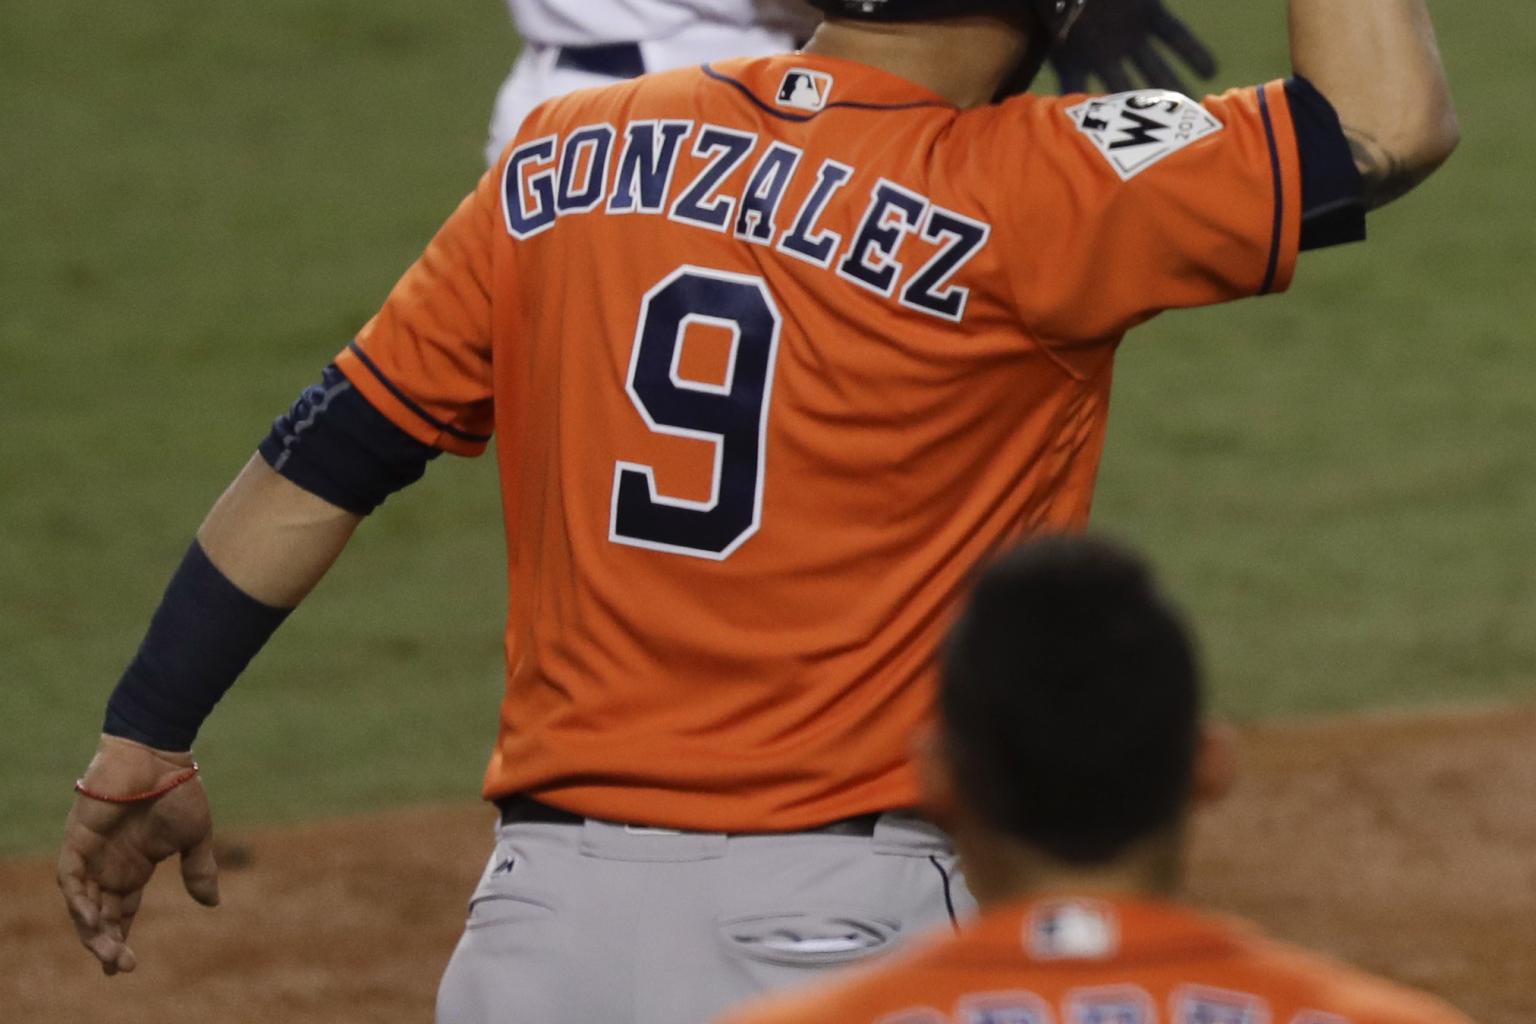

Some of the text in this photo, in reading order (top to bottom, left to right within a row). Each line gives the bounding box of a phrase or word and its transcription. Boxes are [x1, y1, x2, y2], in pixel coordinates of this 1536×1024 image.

[501, 119, 992, 323] GONZALEZ
[1108, 93, 1180, 150] WS
[608, 263, 784, 562] 9
